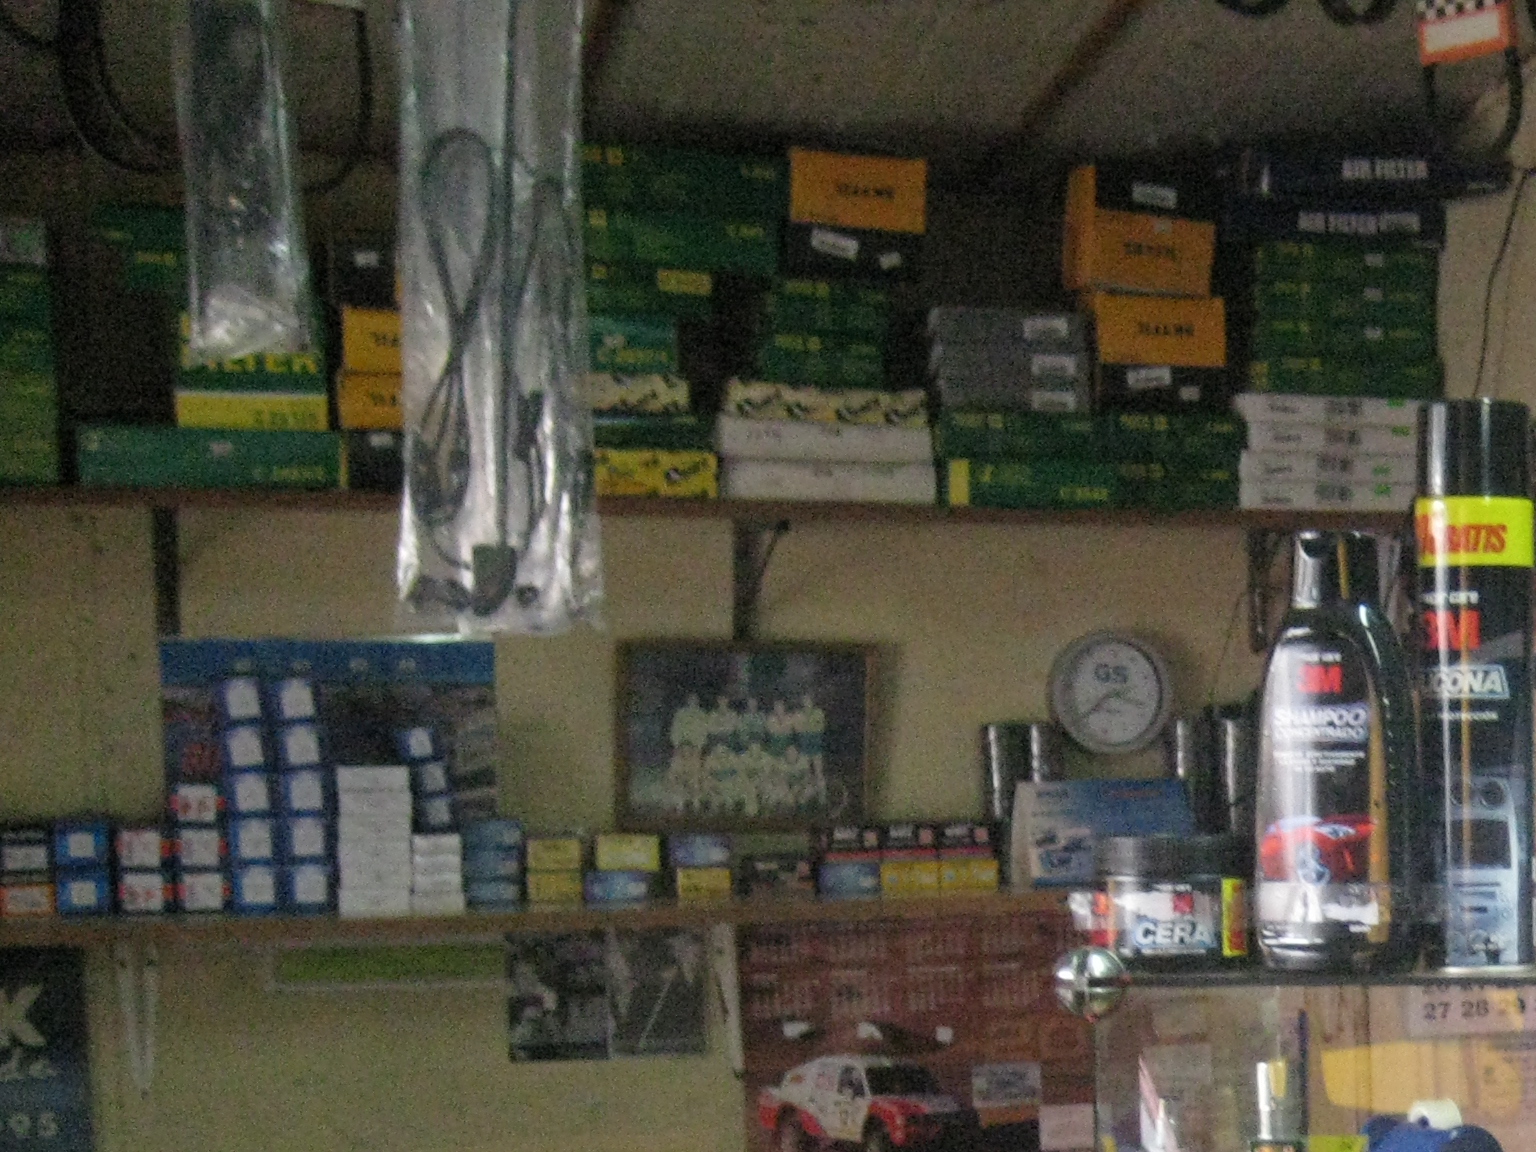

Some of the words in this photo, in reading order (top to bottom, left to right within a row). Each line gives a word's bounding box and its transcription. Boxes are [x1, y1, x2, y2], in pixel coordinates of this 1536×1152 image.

[1135, 919, 1210, 946] CERA
[1423, 1001, 1450, 1020] 27
[1461, 1000, 1490, 1018] 28
